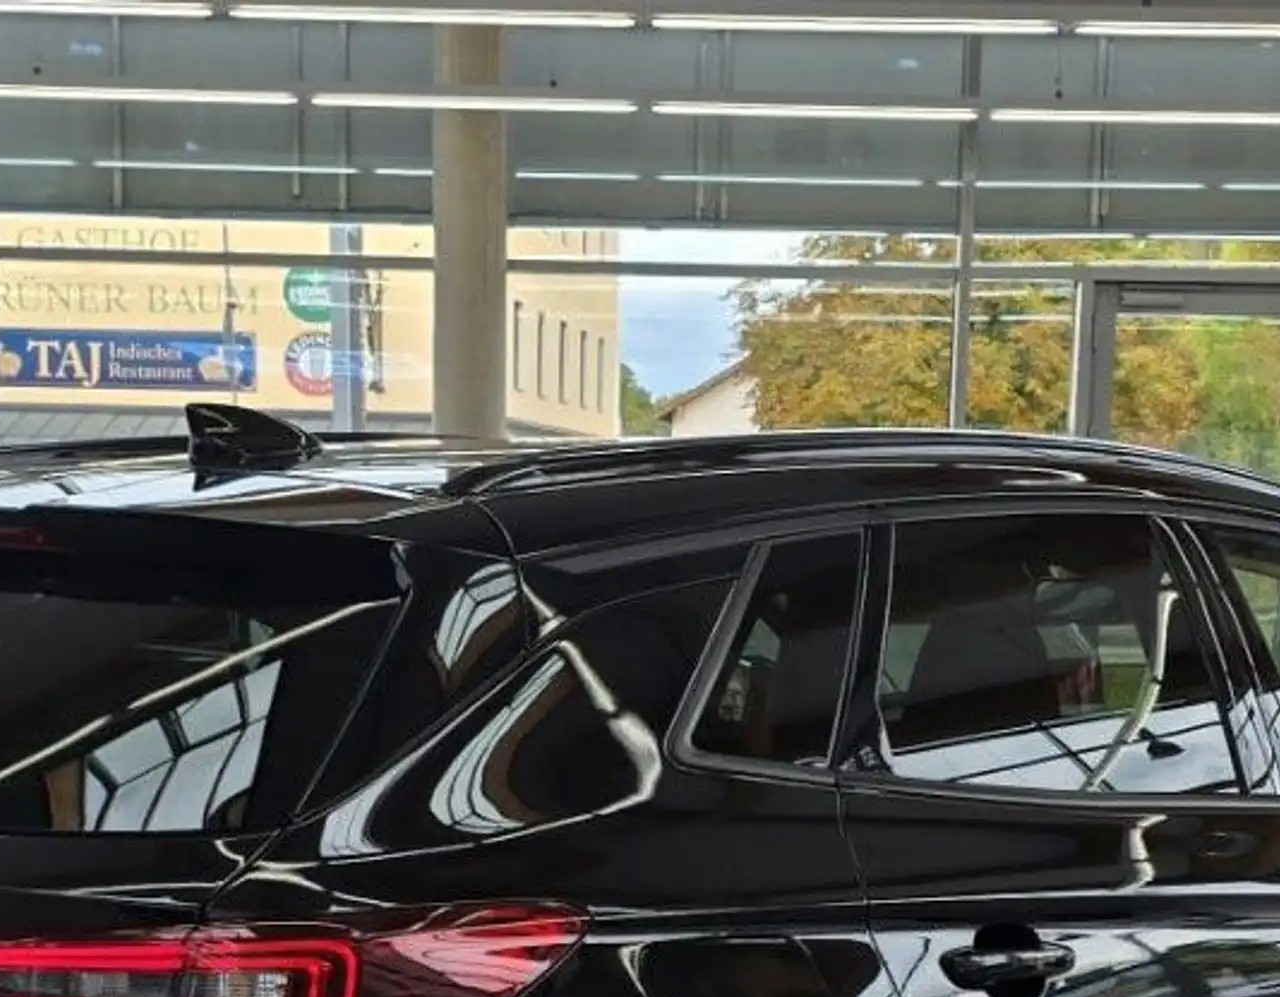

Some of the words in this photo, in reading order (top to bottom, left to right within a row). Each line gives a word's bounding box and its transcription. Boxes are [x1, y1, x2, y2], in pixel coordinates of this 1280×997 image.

[17, 225, 200, 250] GASTHOF
[147, 283, 258, 315] BAUM
[26, 339, 104, 388] TAJ
[109, 341, 183, 361] Indisches
[108, 362, 194, 381] Restaurant
